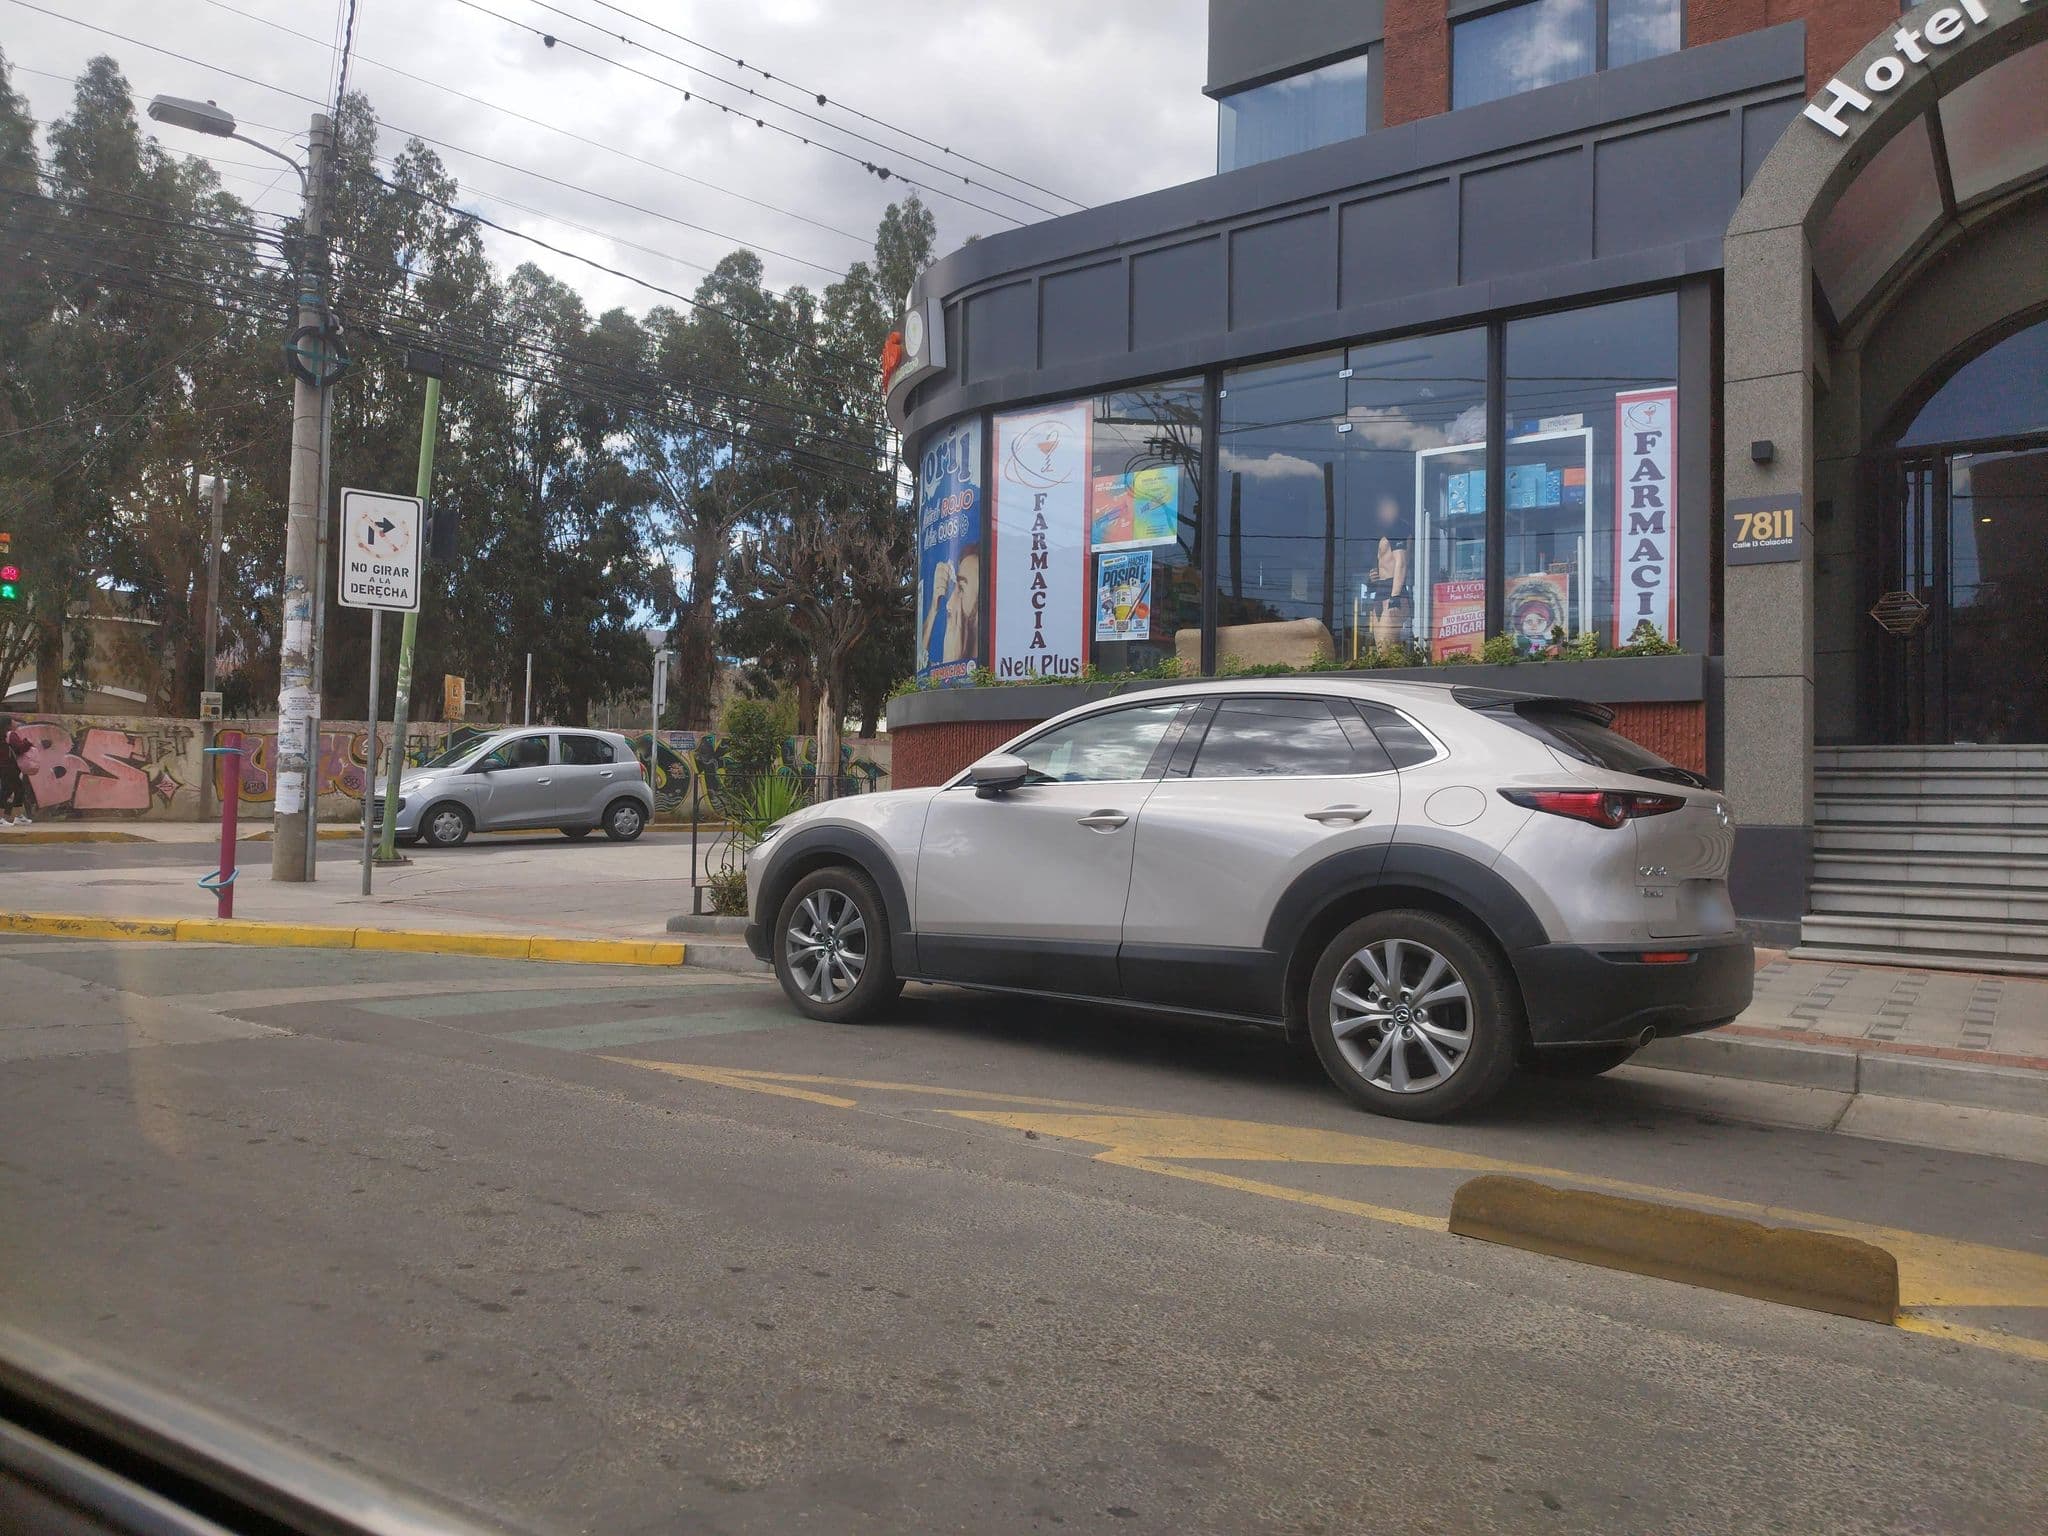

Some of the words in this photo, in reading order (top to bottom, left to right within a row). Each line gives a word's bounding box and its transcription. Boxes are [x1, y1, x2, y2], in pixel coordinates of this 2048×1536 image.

[1803, 0, 1990, 137] Hotel
[1626, 430, 1666, 642] FARMACIA
[1733, 509, 1793, 542] 7811
[1759, 538, 1793, 547] Calacoto
[351, 562, 367, 573] NO
[372, 564, 410, 578] GIRAR
[379, 577, 391, 585] LA
[1029, 492, 1049, 650] FARMACIA
[350, 582, 408, 598] DERECHA
[1000, 656, 1034, 677] Nell
[1041, 654, 1080, 676] Plus
